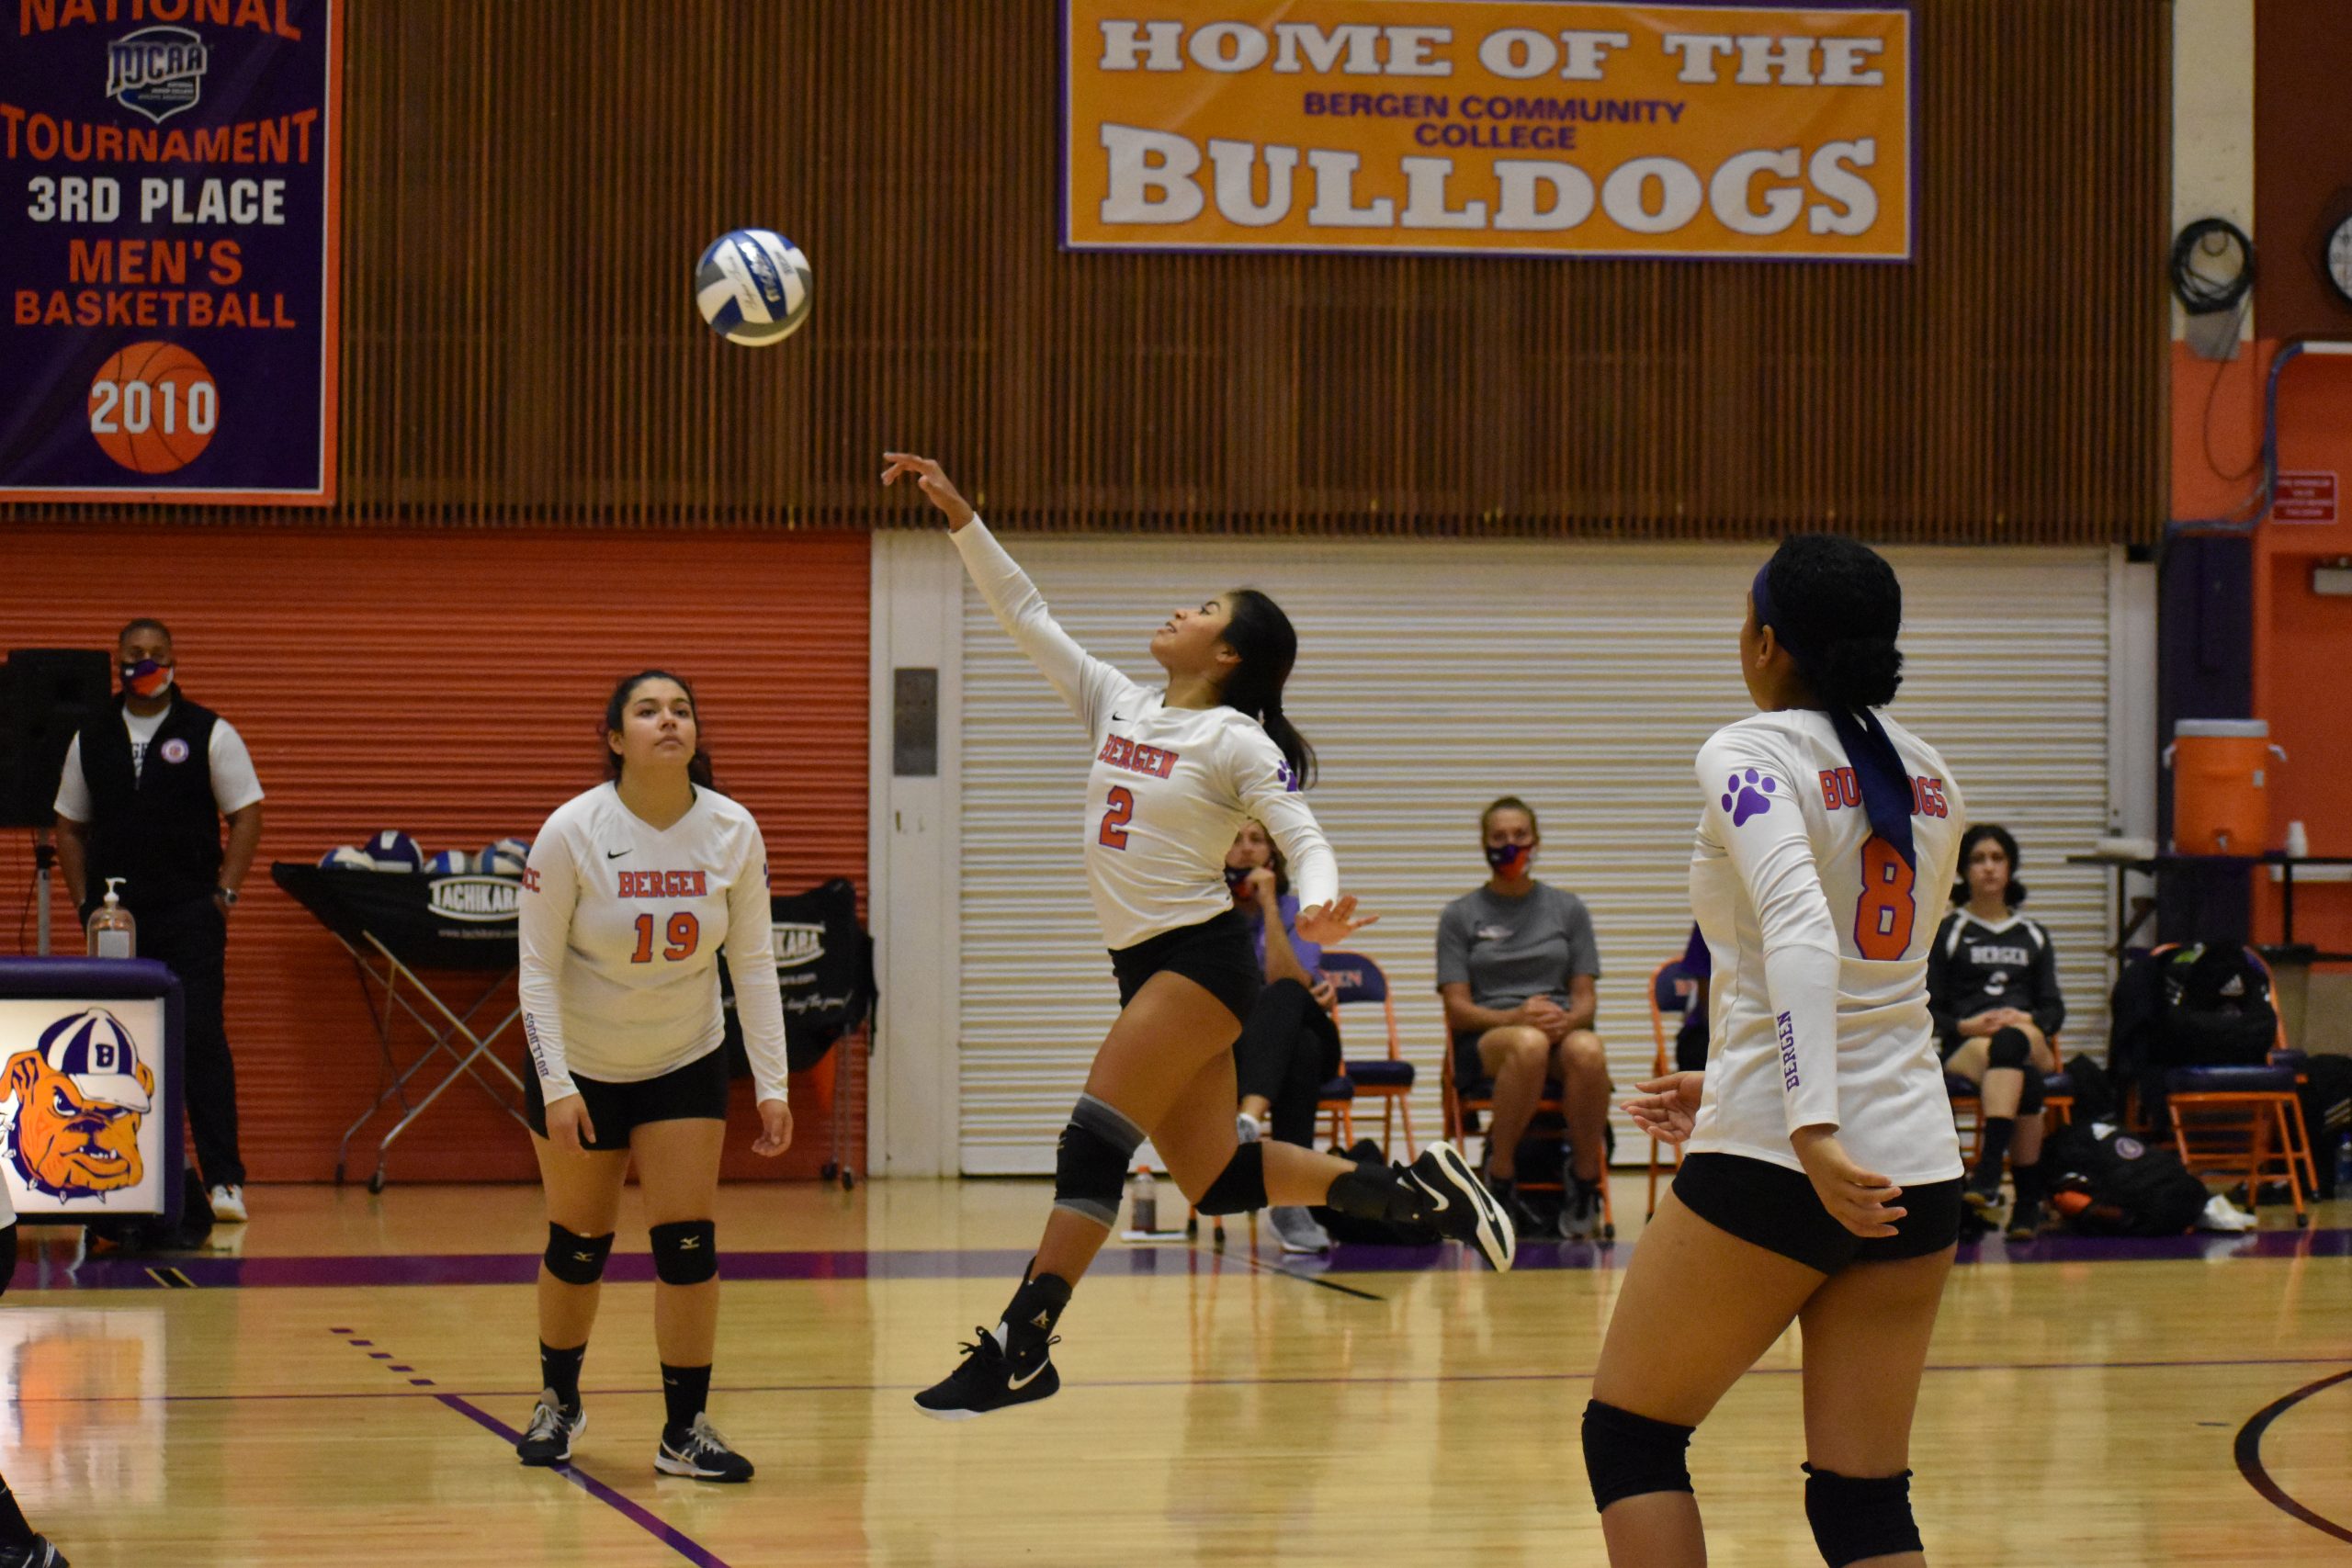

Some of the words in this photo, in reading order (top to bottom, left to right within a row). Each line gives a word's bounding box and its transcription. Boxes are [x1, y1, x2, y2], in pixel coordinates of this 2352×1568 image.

[1099, 19, 1453, 76] HOME
[1478, 28, 1629, 81] OF
[1663, 33, 1883, 86] THE
[0, 104, 317, 164] TOURNAMENT
[1303, 92, 1449, 119] BERGEN
[1459, 95, 1686, 124] COMMUNITY
[1414, 122, 1577, 150] COLLEGE
[28, 177, 120, 222] 3RD
[141, 179, 286, 225] PLACE
[1100, 123, 1879, 236] BULLDOGS
[69, 239, 243, 286] MEN'S
[15, 290, 295, 329] BASKETBALL
[91, 381, 216, 434] 2010
[1097, 734, 1180, 779] BERGEN
[1099, 785, 1134, 851] 2
[618, 871, 707, 898] BERGEN
[1853, 835, 1916, 962] 8
[631, 911, 699, 964] 19
[95, 1043, 114, 1067] B
[525, 1012, 549, 1077] BULLDOGS
[1777, 1010, 1800, 1092] BERGEN
